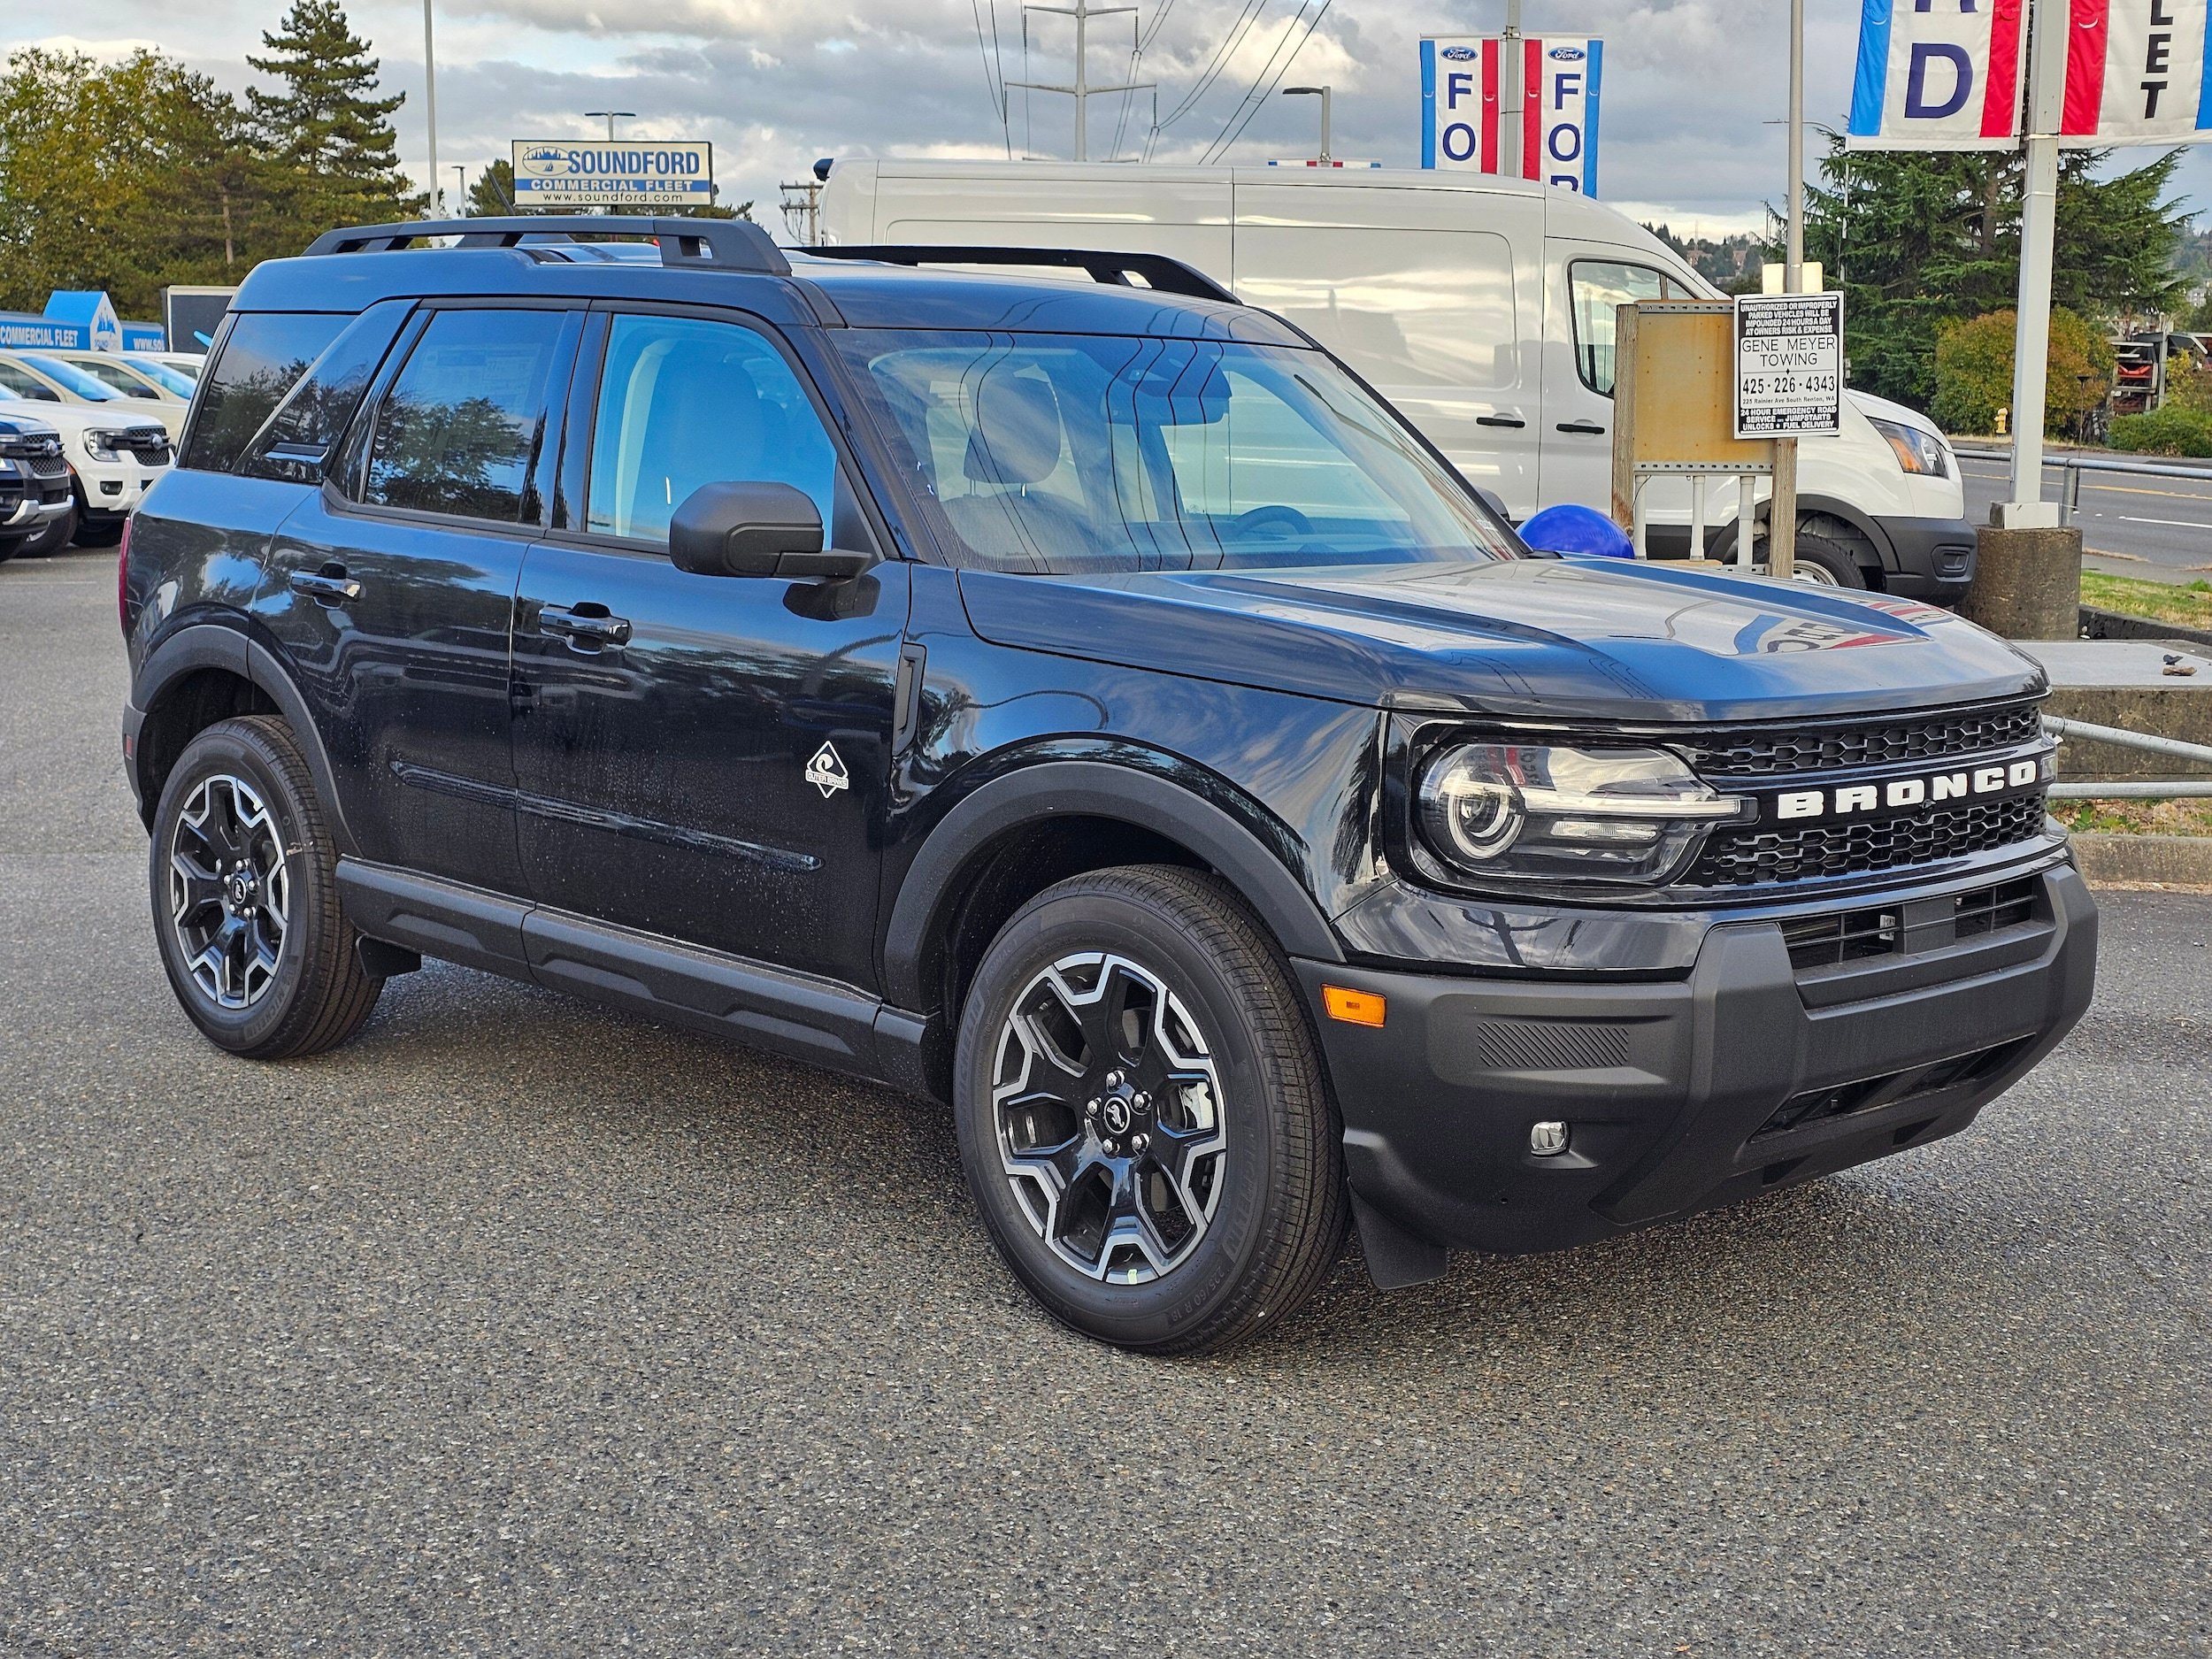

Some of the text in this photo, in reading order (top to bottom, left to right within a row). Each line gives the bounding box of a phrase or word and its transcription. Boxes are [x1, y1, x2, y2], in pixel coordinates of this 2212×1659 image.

[1446, 48, 1474, 60] Ford
[1554, 48, 1582, 60] Ford
[1904, 0, 1978, 119] D
[567, 150, 700, 174] SOUNDFORD
[531, 180, 693, 191] COMMERCIAL FLEET
[543, 192, 682, 203] www.soundford.com
[1740, 303, 1787, 312] UNAUTHORIZED
[1798, 301, 1837, 310] IMPROPERLY
[0, 325, 79, 347] COMMERCIAL FLEET
[1746, 327, 1754, 336] AT
[1754, 326, 1781, 335] OWNERS
[1803, 325, 1832, 334] EXPENSE
[1742, 337, 1835, 352] GENE MEYER
[1760, 353, 1817, 366] TOWING
[1743, 375, 1835, 395] 425 226 4343
[1778, 760, 2037, 819] BRONCO
